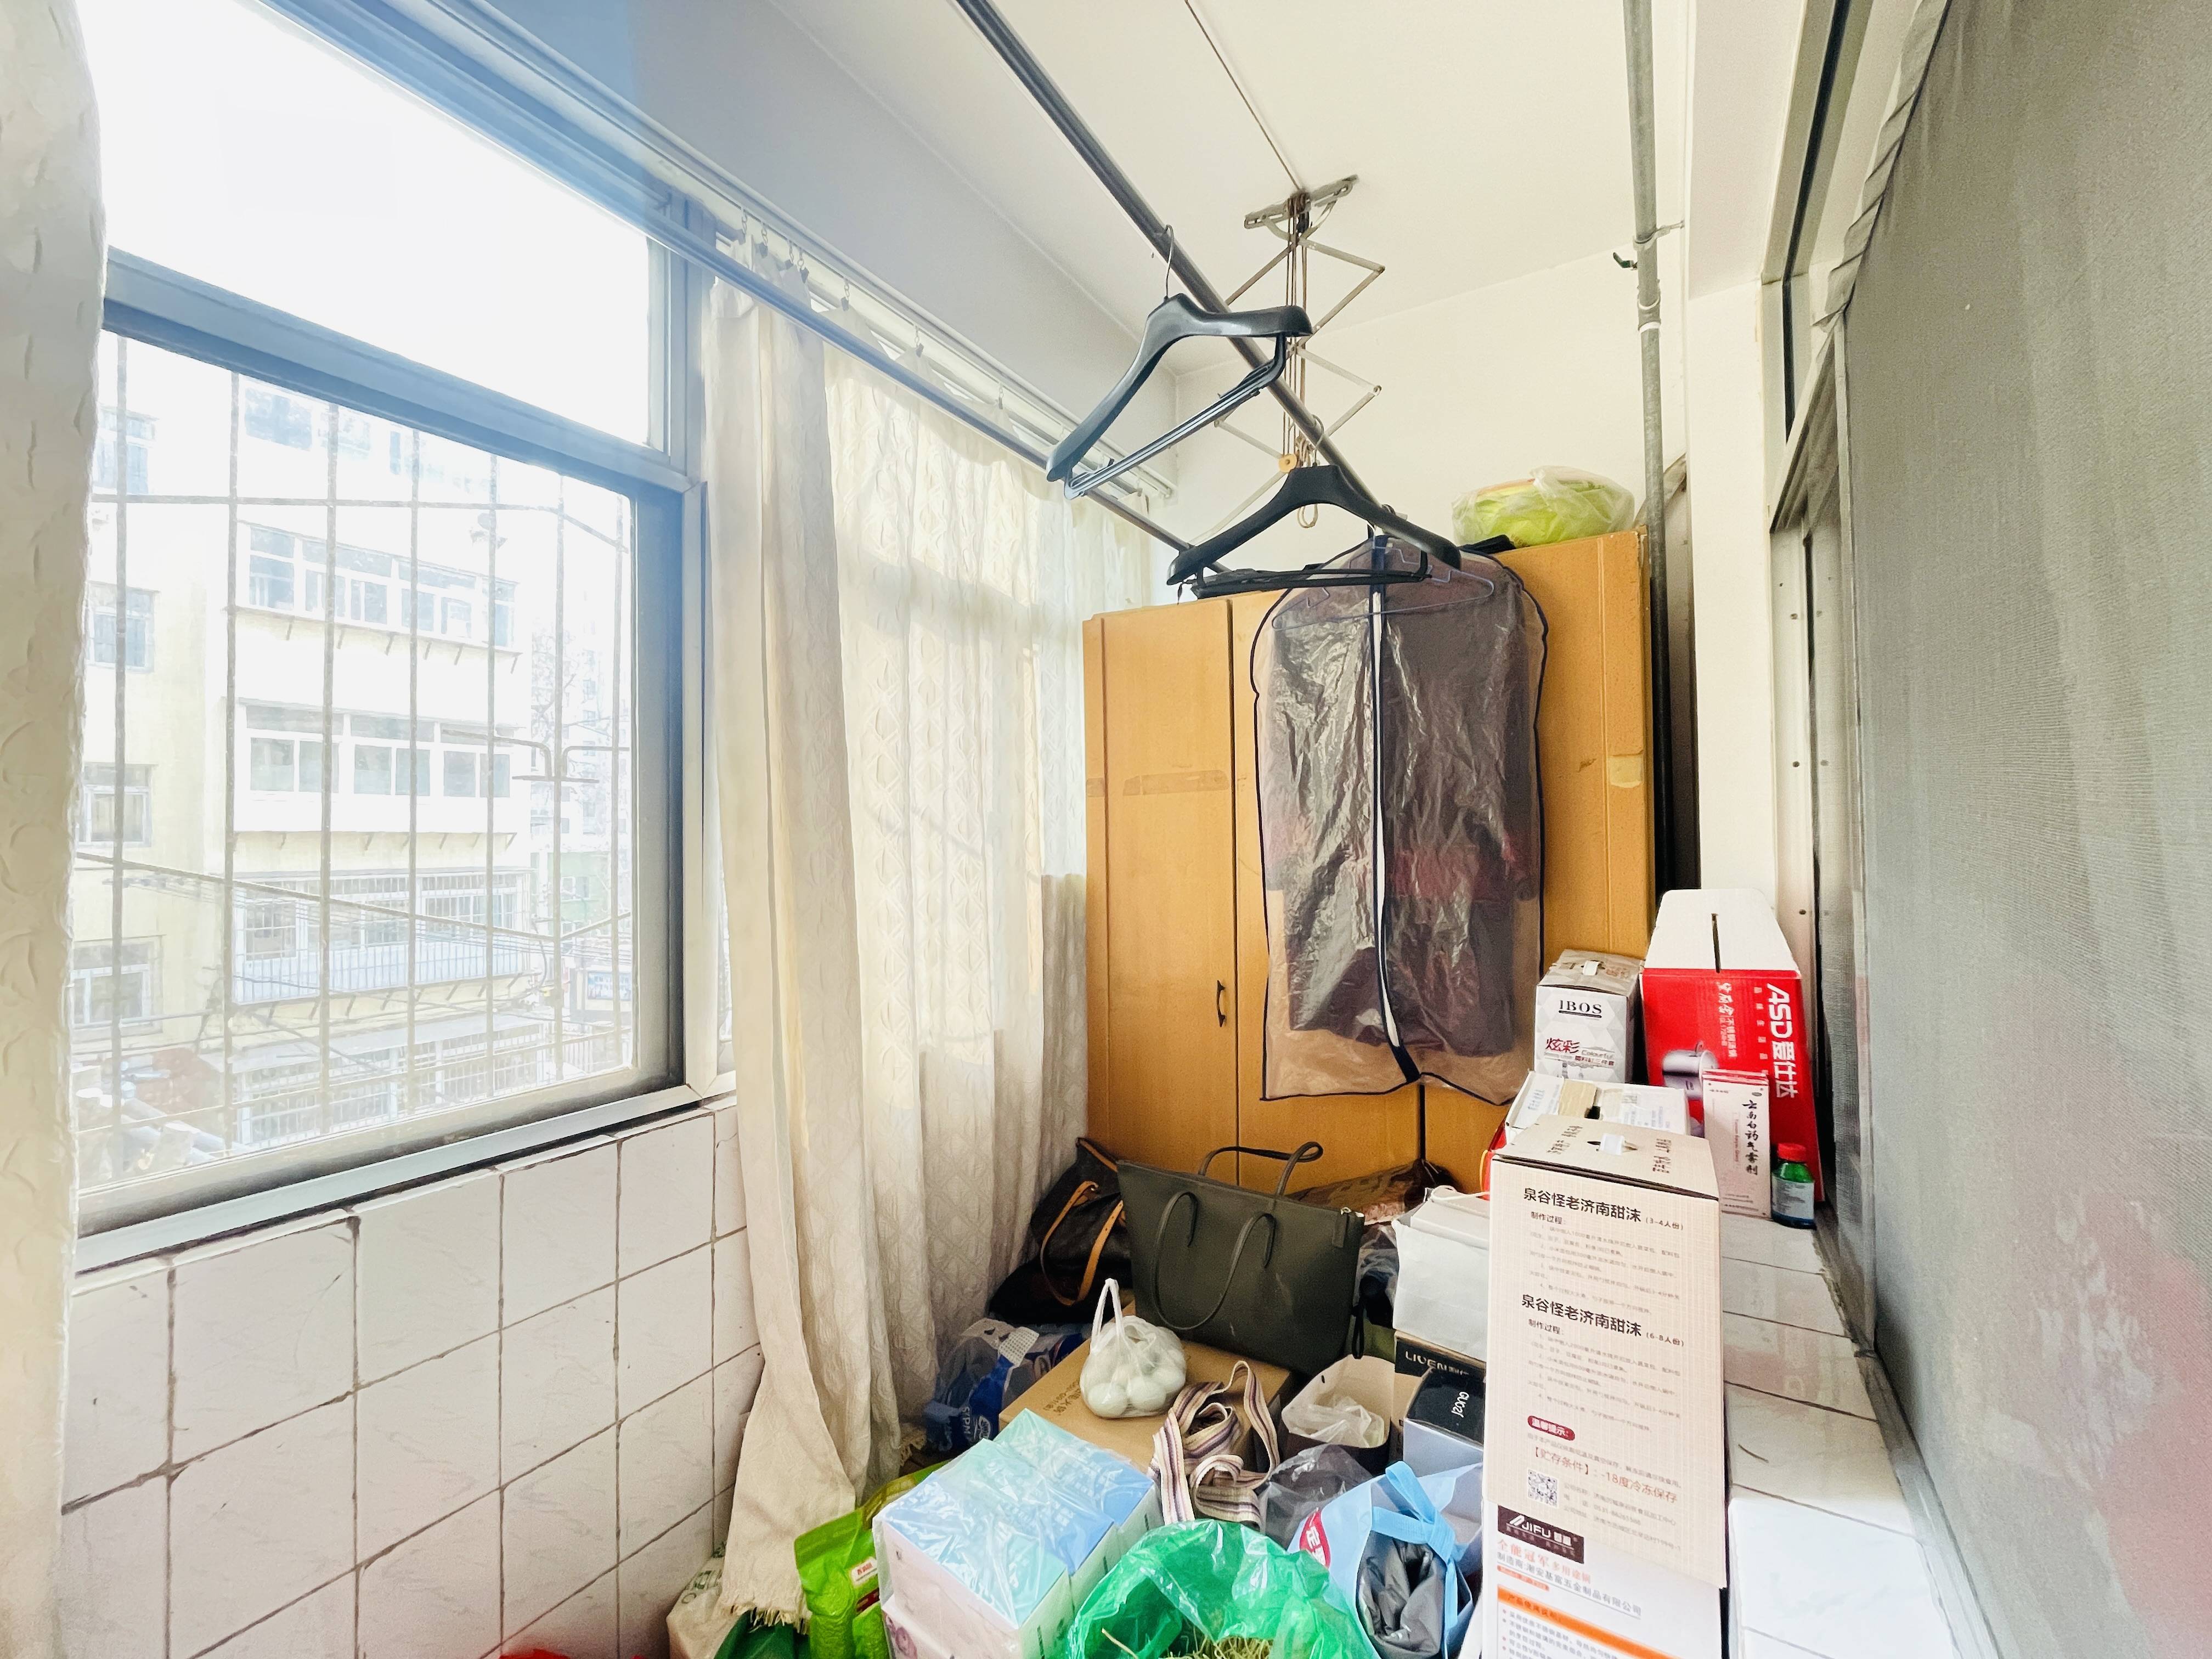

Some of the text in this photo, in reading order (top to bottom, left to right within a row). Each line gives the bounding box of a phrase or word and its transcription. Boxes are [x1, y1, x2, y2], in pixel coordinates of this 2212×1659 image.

[1559, 999, 1602, 1014] IBOS
[1545, 1037, 1580, 1054] 炫彩
[1767, 983, 1798, 1098] ASD 爱仕达
[1523, 1187, 1641, 1222] 泉谷怪老济南甜沫
[1521, 1294, 1641, 1337] 泉谷怪老济南甜沫
